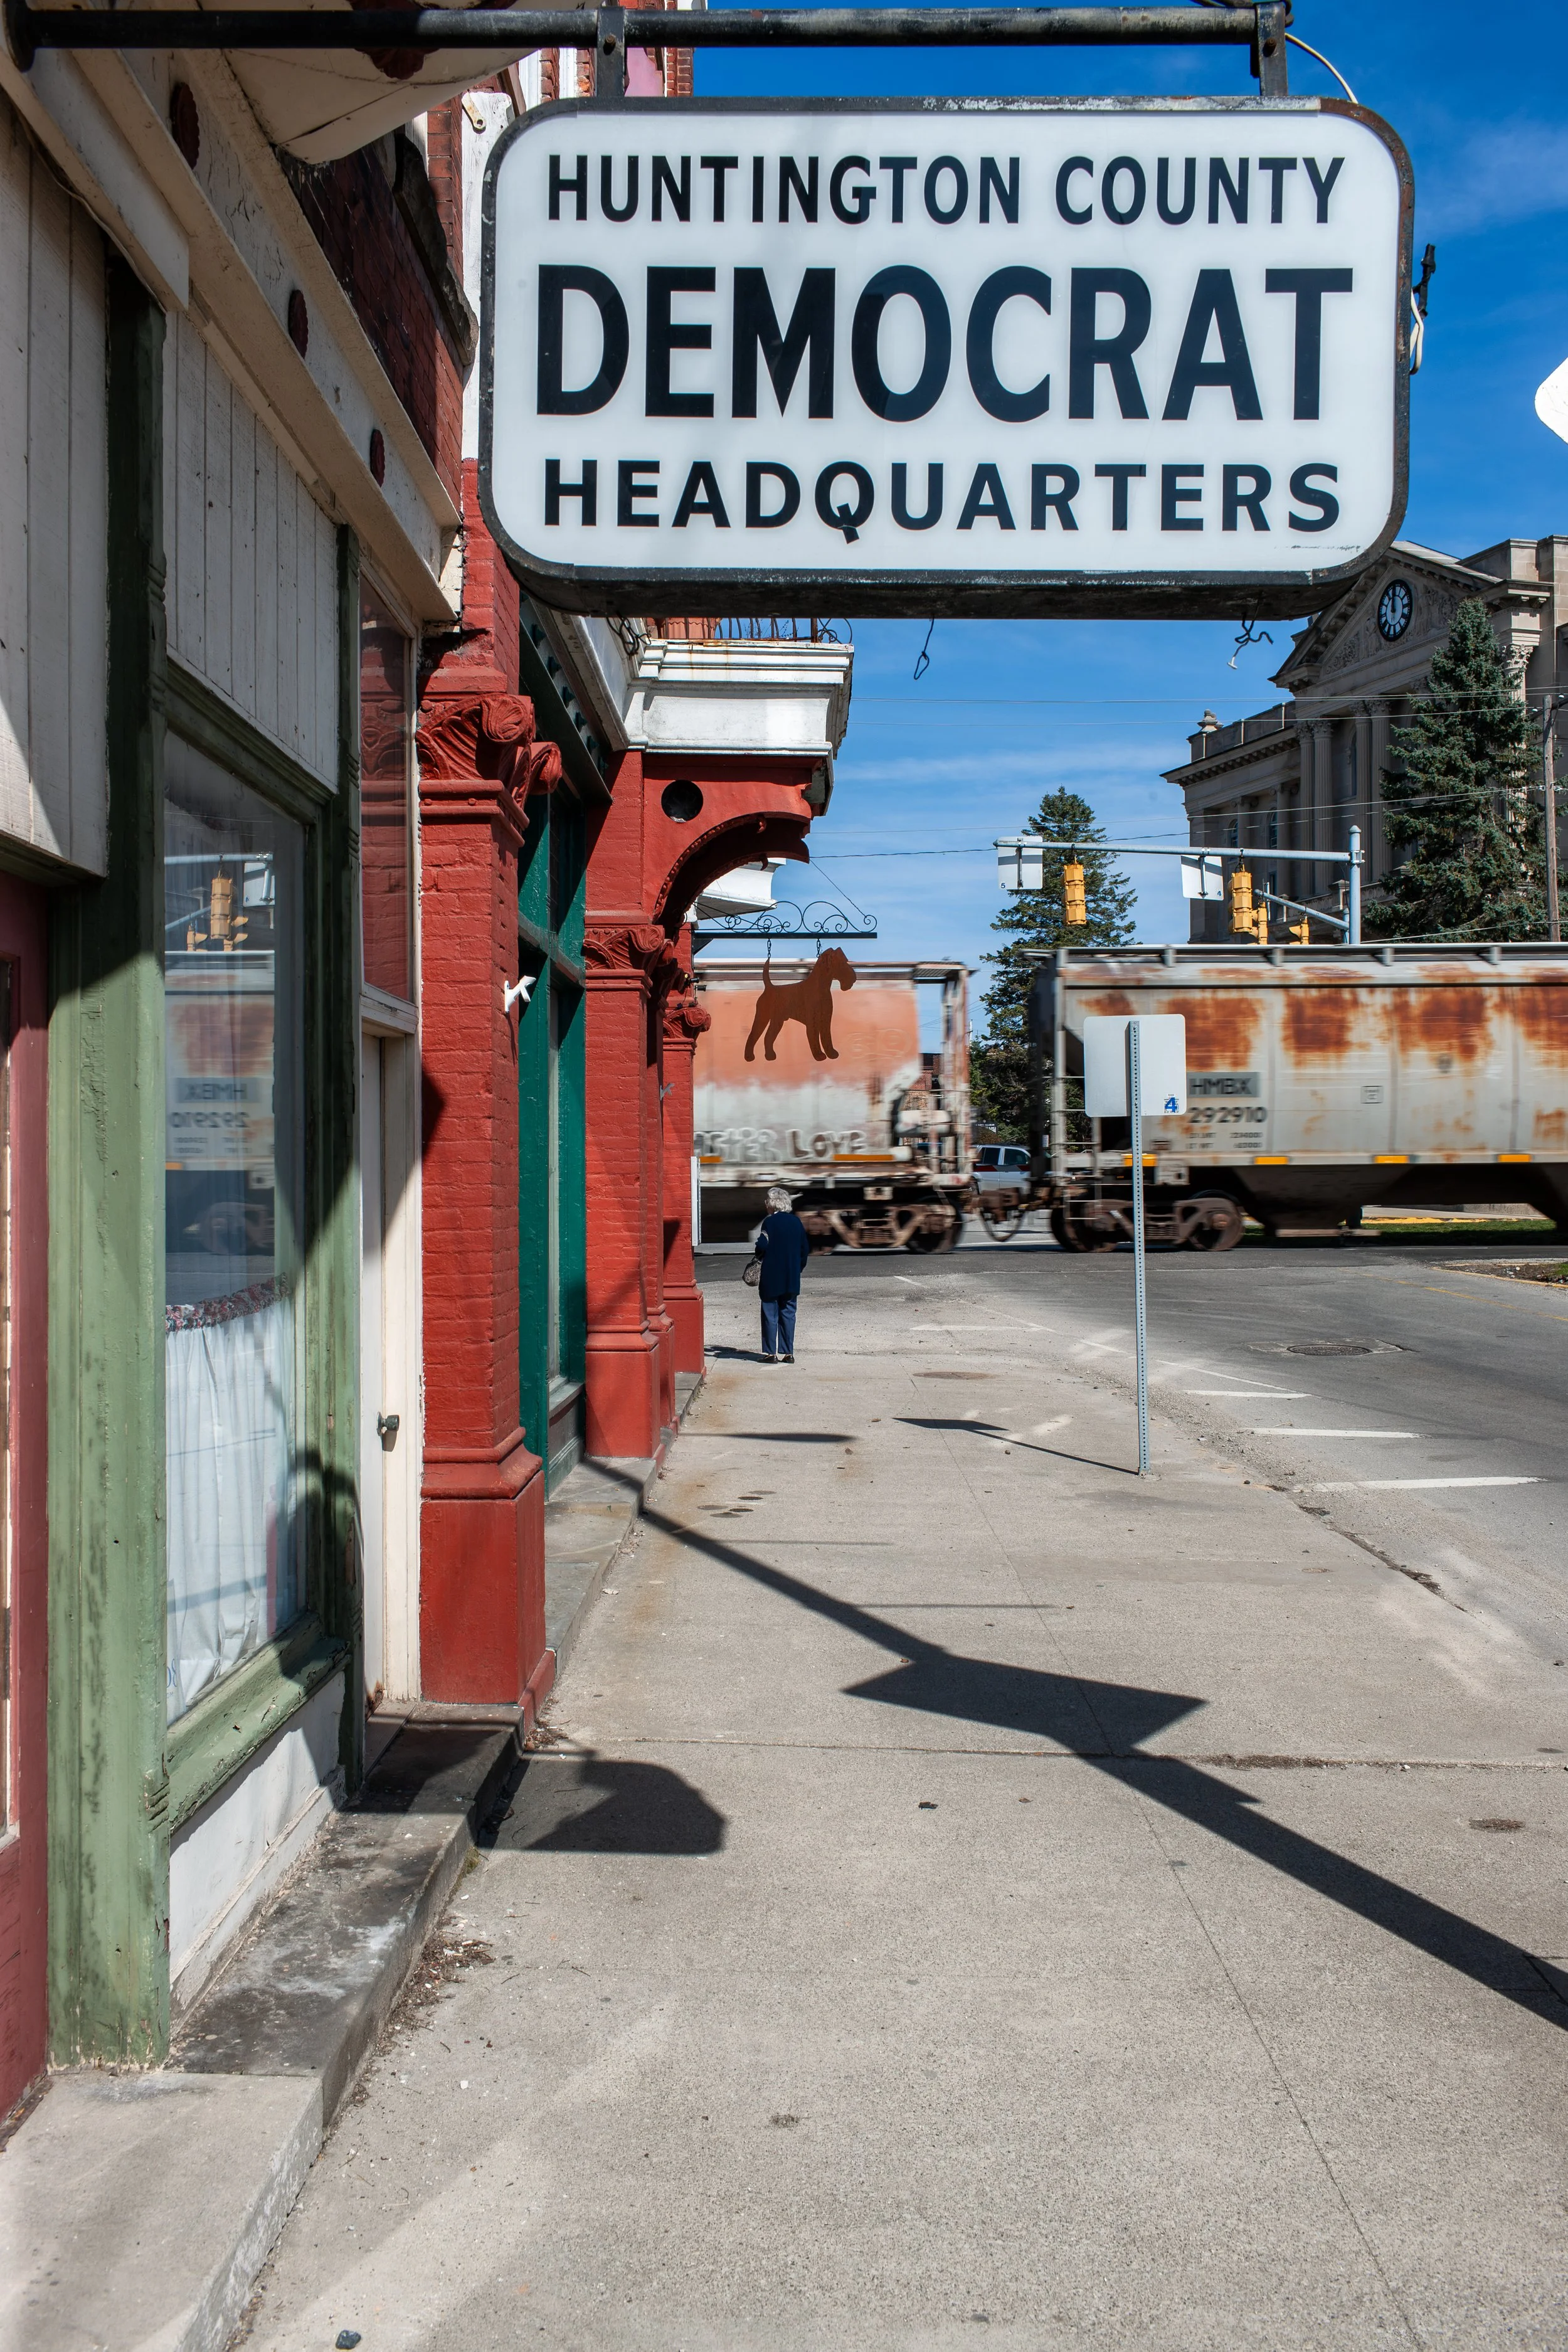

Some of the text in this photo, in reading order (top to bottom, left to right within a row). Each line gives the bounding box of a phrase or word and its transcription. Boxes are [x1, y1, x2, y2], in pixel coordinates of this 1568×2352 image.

[549, 155, 1345, 225] HUNTINGTON COUNTY
[537, 264, 1353, 422] DEMOCRAT
[544, 458, 1340, 544] HEADQUARTERS
[1165, 1097, 1178, 1113] 4
[1187, 1106, 1268, 1123] 292910
[785, 1128, 867, 1160] LOVE
